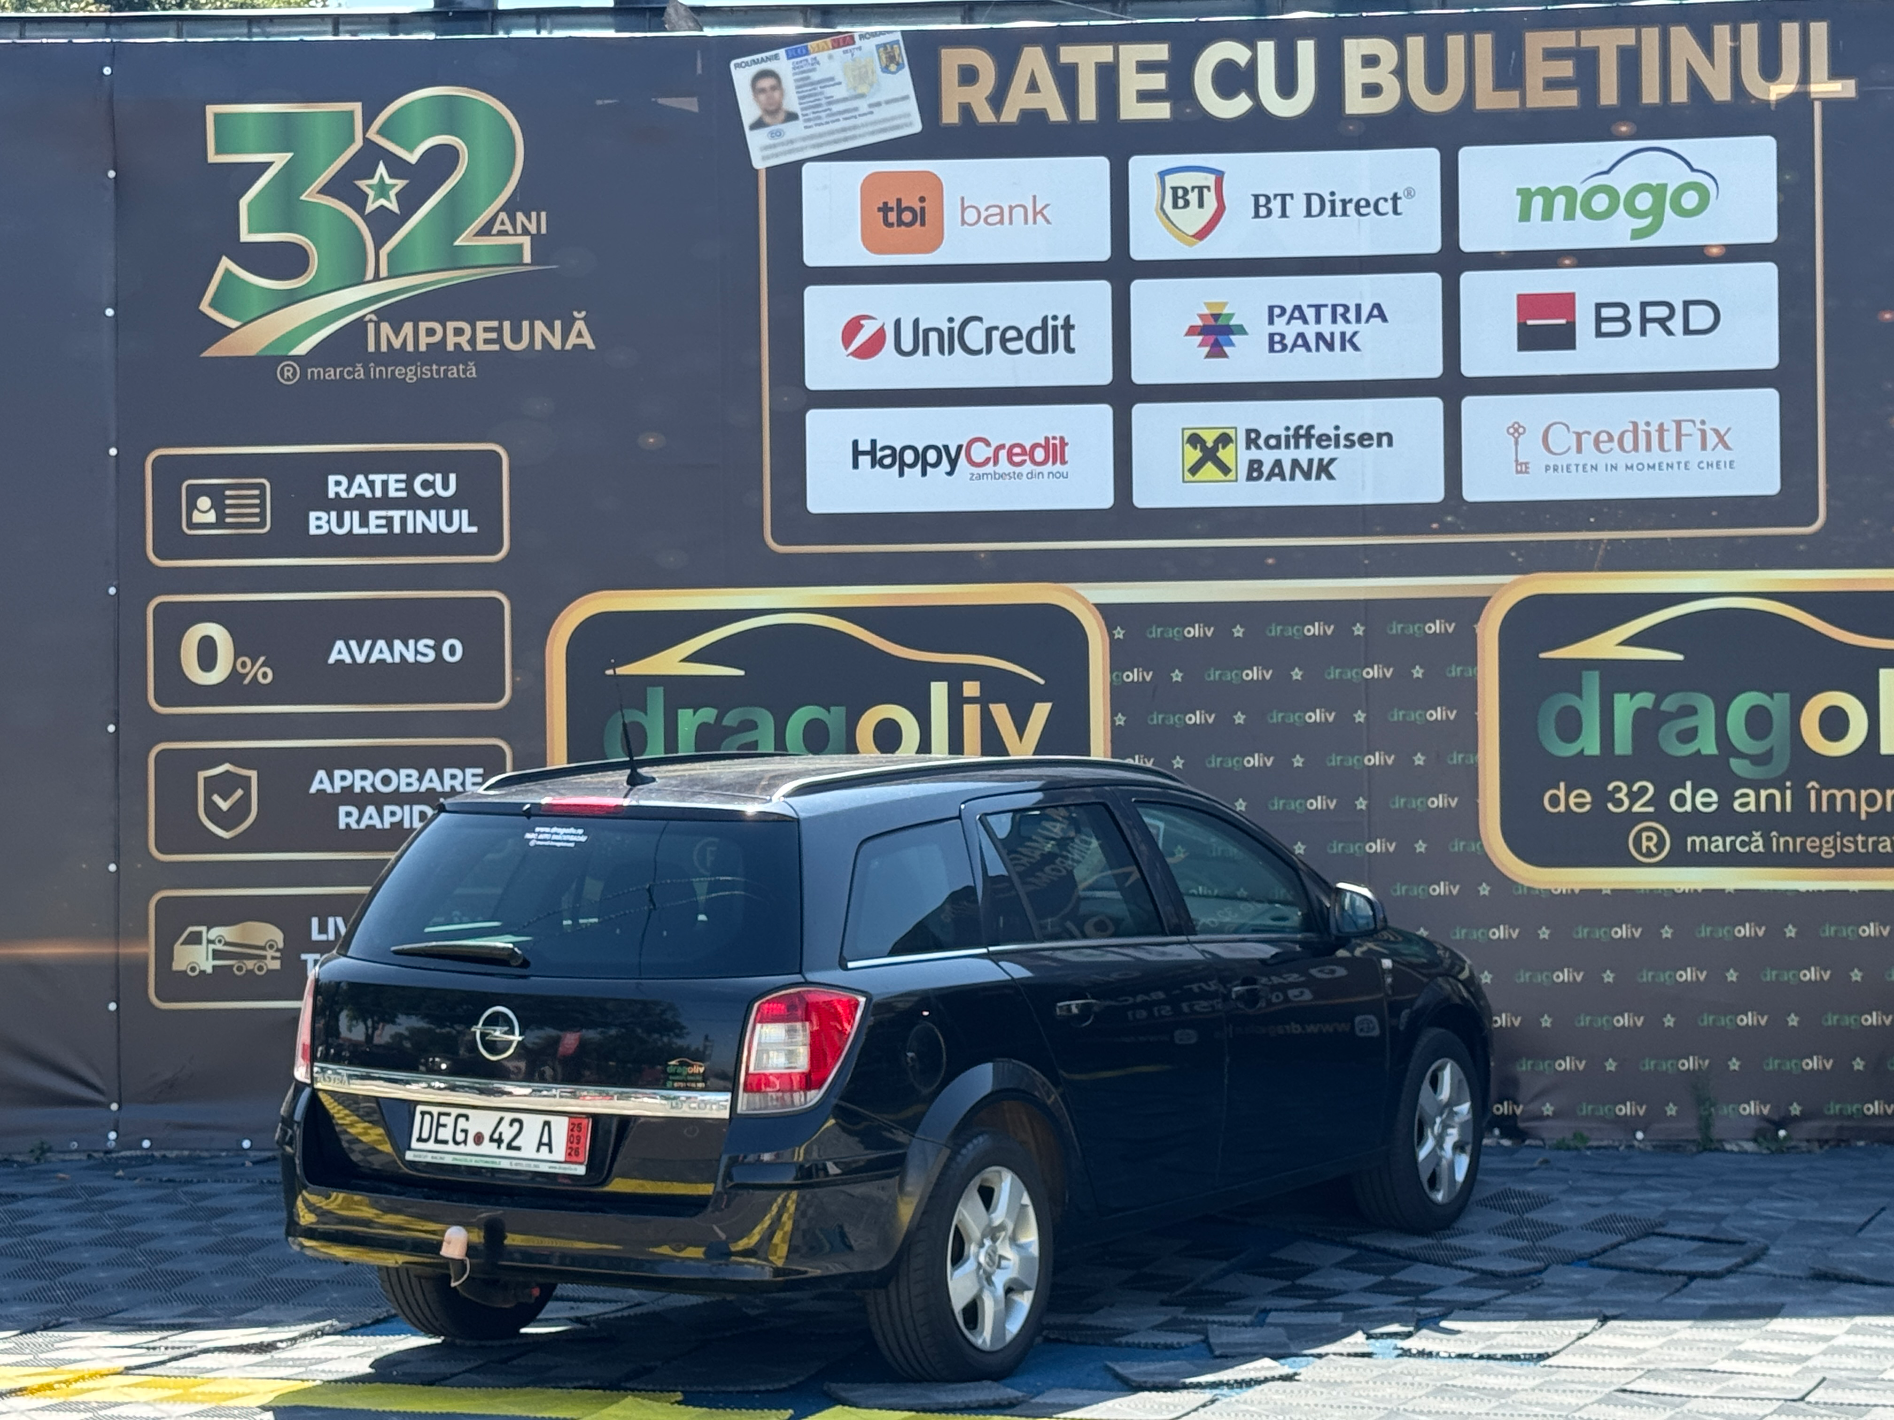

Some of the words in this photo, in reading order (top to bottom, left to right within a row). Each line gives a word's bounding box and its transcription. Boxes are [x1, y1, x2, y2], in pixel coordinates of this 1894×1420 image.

[734, 53, 780, 70] ROUMANIE
[940, 44, 1171, 124] RATE
[1194, 39, 1316, 120] CU
[1343, 20, 1857, 115] BULETINUL
[1169, 183, 1212, 211] BT
[1251, 192, 1294, 219] BT
[199, 85, 531, 328] 32
[877, 195, 926, 228] tbi
[959, 195, 1052, 227] bank
[1516, 180, 1711, 241] mogo
[491, 210, 547, 236] ANI
[1267, 302, 1389, 326] PATRIA
[1594, 299, 1721, 339] BRD
[364, 310, 596, 353] ÎMPREUNĂ
[893, 313, 1076, 358] UniCredit
[1267, 330, 1362, 354] BANK
[306, 361, 365, 381] marcă
[369, 360, 477, 383] înregistrată
[1244, 424, 1394, 451] Raiffeisen
[1541, 419, 1733, 456] CreditFix
[852, 435, 1069, 478] HappyCredit
[969, 469, 1023, 481] zambeste
[1026, 469, 1044, 480] din
[1047, 470, 1069, 480] nou
[1245, 457, 1338, 482] BANK
[1544, 463, 1599, 474] PRIETEN
[1605, 462, 1618, 473] IN
[1625, 461, 1691, 472] MOMENTE
[1697, 460, 1736, 471] CHEIE
[327, 473, 407, 499] RATE
[413, 473, 457, 498] CU
[309, 509, 478, 535] BULETINUL
[1146, 623, 1214, 640] dragoliv
[1265, 621, 1334, 639] dragoliv
[1386, 619, 1456, 637] dragoliv
[327, 638, 436, 664] AVANS
[442, 638, 463, 663] 0
[1111, 667, 1153, 685] goliv
[1204, 666, 1273, 683] dragoliv
[1324, 664, 1394, 681] dragoliv
[1147, 710, 1216, 727] dragoliv
[1267, 708, 1336, 726] dragoliv
[1387, 706, 1457, 724] dragoliv
[1537, 668, 1894, 779] dragol
[1205, 753, 1274, 770] dragoliv
[1325, 751, 1395, 768] dragoliv
[309, 767, 484, 794] APROBARE
[1268, 796, 1337, 813] dragoliv
[1388, 794, 1458, 811] dragoliv
[1543, 781, 1592, 813] de
[1606, 781, 1656, 813] 32
[1669, 781, 1719, 813] de
[1733, 781, 1792, 813] ani
[1806, 781, 1894, 820] împr
[338, 804, 436, 830] RAPID
[1327, 839, 1396, 856] dragoliv
[1448, 838, 1484, 854] drag
[1687, 830, 1764, 853] marcă
[1771, 830, 1894, 859] înregistra
[1390, 881, 1460, 898] dragoliv
[1450, 924, 1520, 941] dragoliv
[1573, 924, 1642, 941] dragoliv
[1696, 922, 1766, 940] dragoliv
[1819, 922, 1891, 940] dragoliv
[1515, 968, 1584, 986] dragoliv
[1637, 967, 1707, 985] dragoliv
[1760, 966, 1831, 984] dragoliv
[1492, 1013, 1521, 1028] oliv
[1575, 1013, 1644, 1030] dragoliv
[1698, 1012, 1768, 1029] dragoliv
[1822, 1011, 1893, 1028] dragoliv
[1515, 1057, 1586, 1074] dragoliv
[1639, 1056, 1709, 1074] dragoliv
[1763, 1055, 1834, 1073] dragoliv
[1493, 1101, 1523, 1115] oliv
[1576, 1101, 1646, 1118] dragoliv
[416, 1110, 470, 1146] DEG
[489, 1115, 524, 1151] 42
[536, 1120, 553, 1154] A
